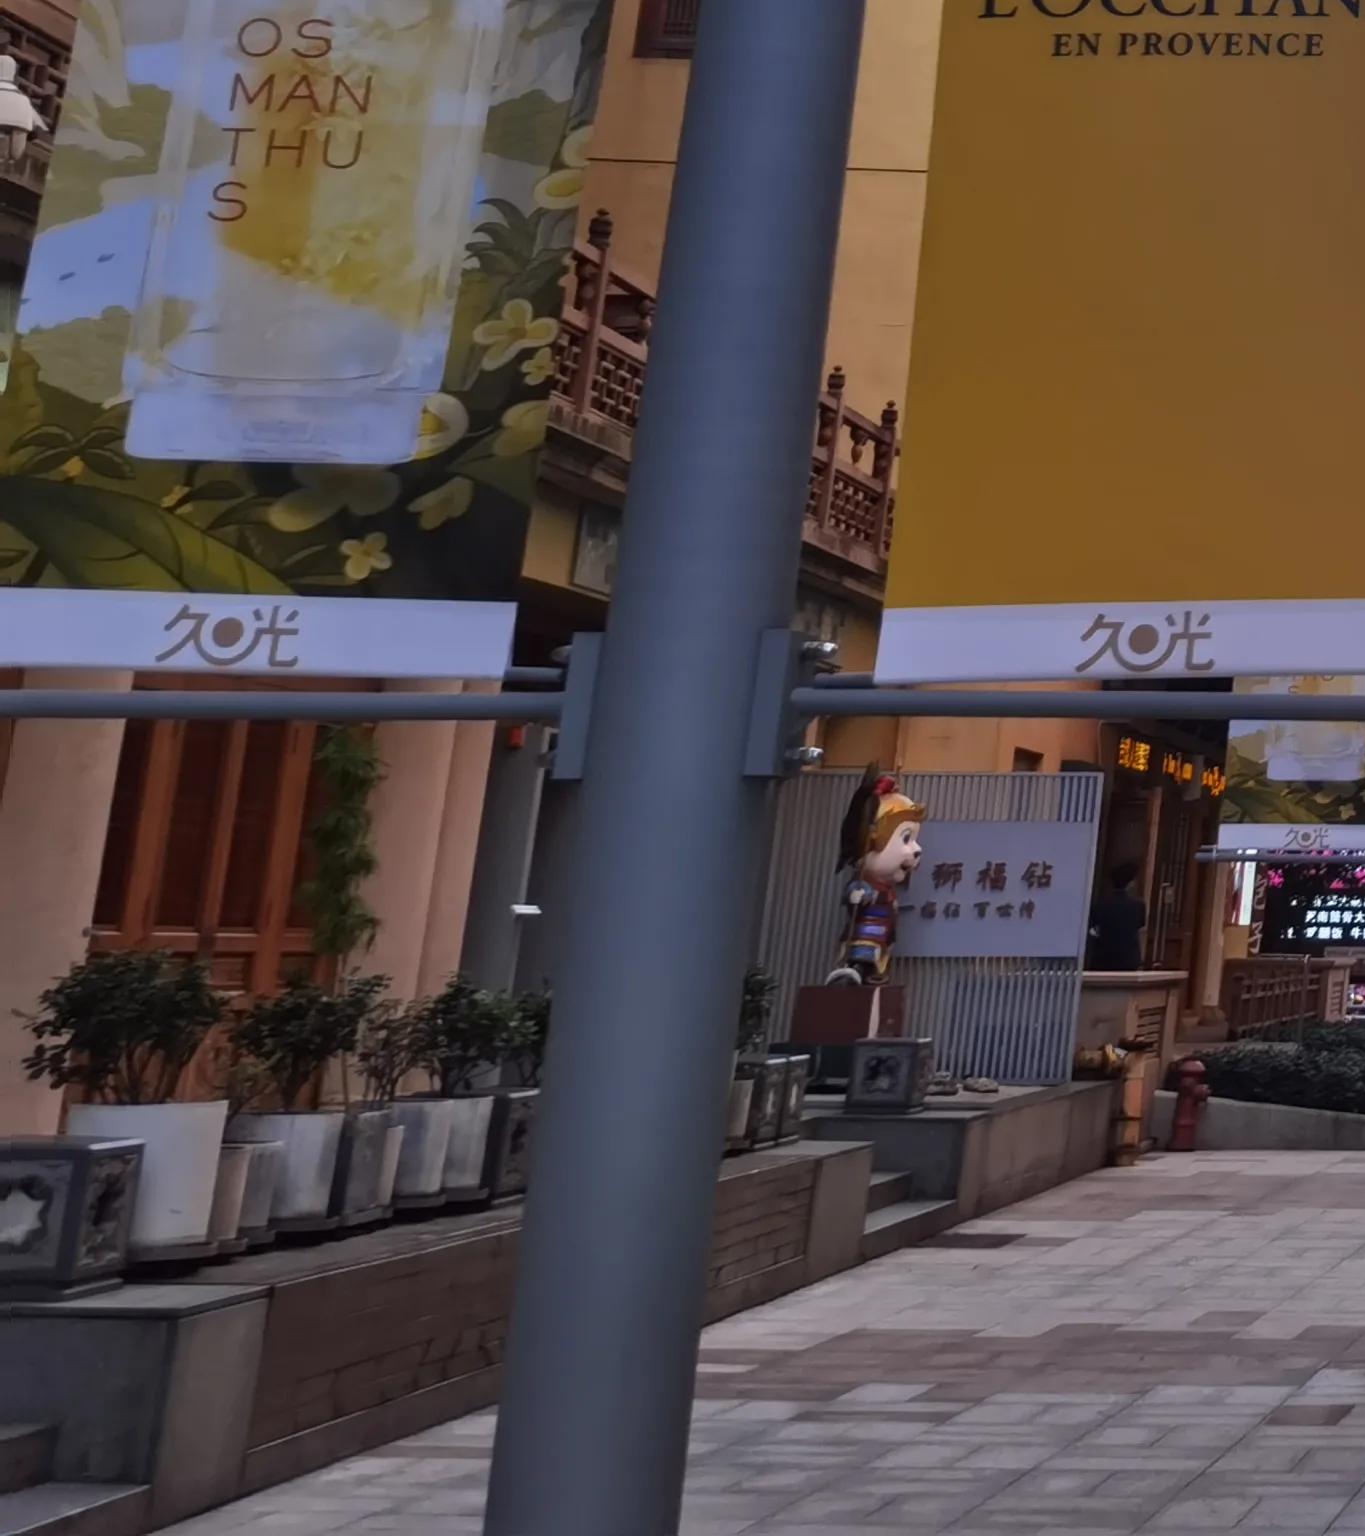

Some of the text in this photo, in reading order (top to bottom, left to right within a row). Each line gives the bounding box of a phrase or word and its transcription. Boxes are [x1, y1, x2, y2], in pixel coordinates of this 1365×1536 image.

[237, 17, 333, 59] OS
[1052, 31, 1325, 57] EN PROVENCE
[228, 73, 373, 114] MAN
[221, 128, 365, 169] THU
[206, 181, 248, 222] S
